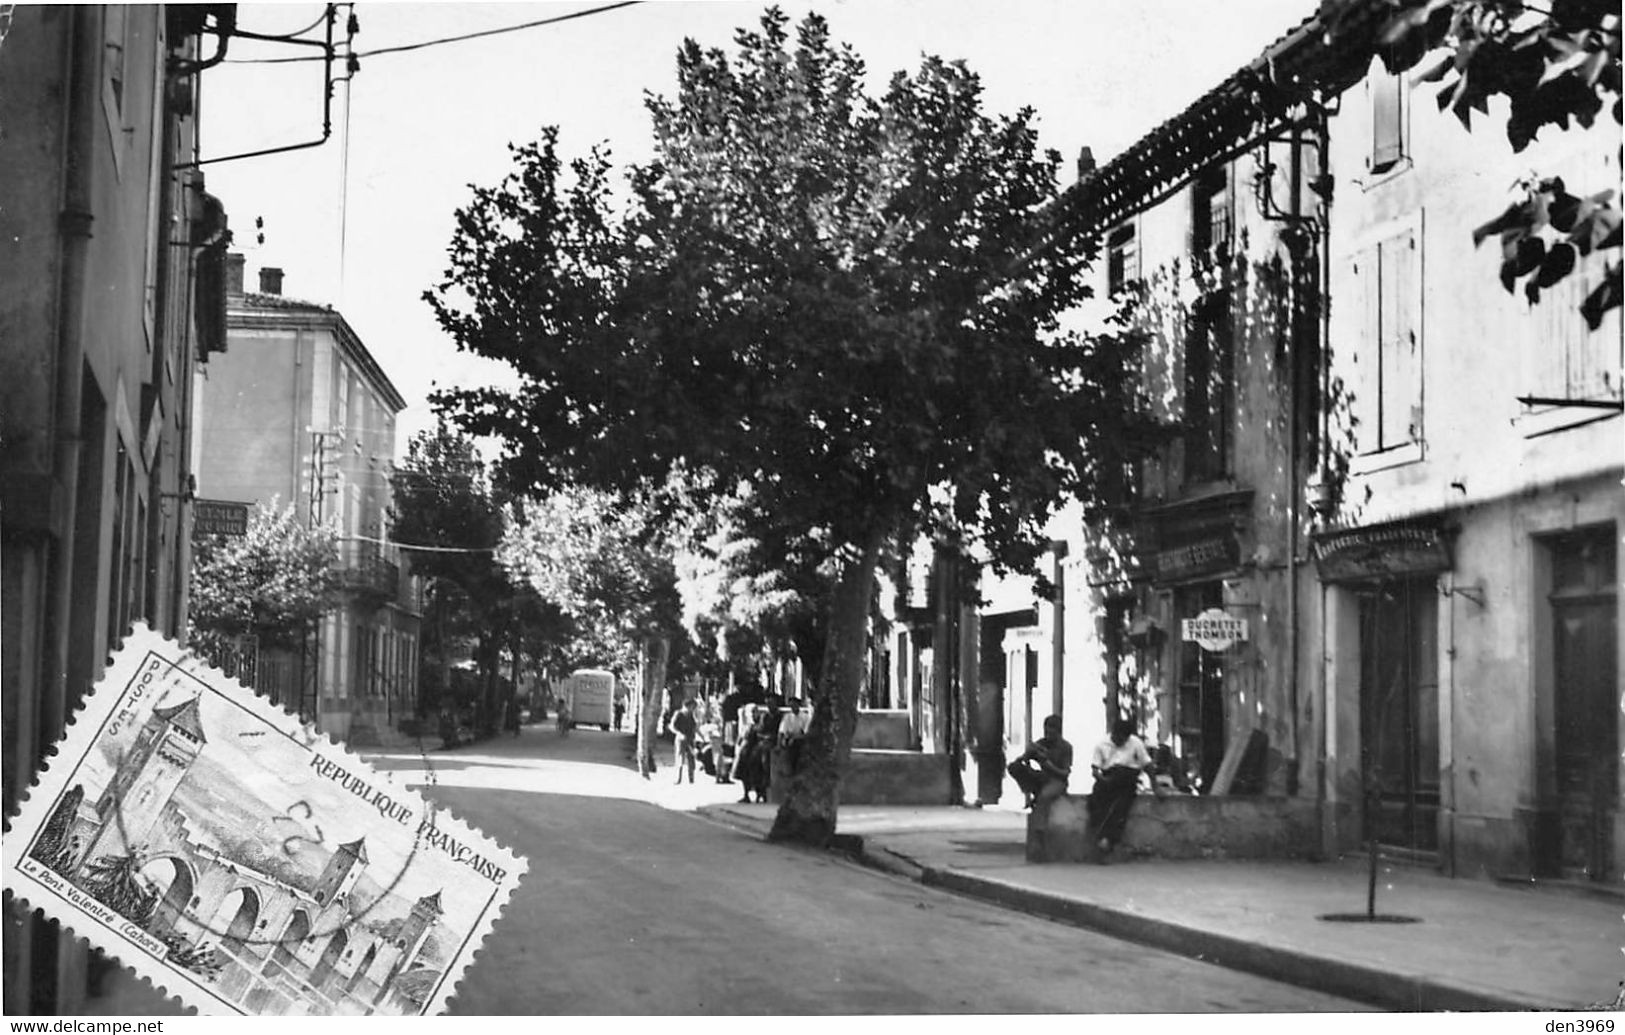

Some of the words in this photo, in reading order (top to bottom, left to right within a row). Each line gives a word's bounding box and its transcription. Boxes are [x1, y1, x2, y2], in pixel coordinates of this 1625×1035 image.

[1188, 619, 1242, 630] DUCRETET
[1188, 630, 1243, 640] THOMSON
[108, 659, 161, 736] POSTES
[414, 819, 507, 886] FRANÇAISE
[23, 860, 37, 873] Le
[38, 870, 66, 892] Pont
[67, 887, 115, 924] Valentré
[119, 922, 165, 956] (Cahors)
